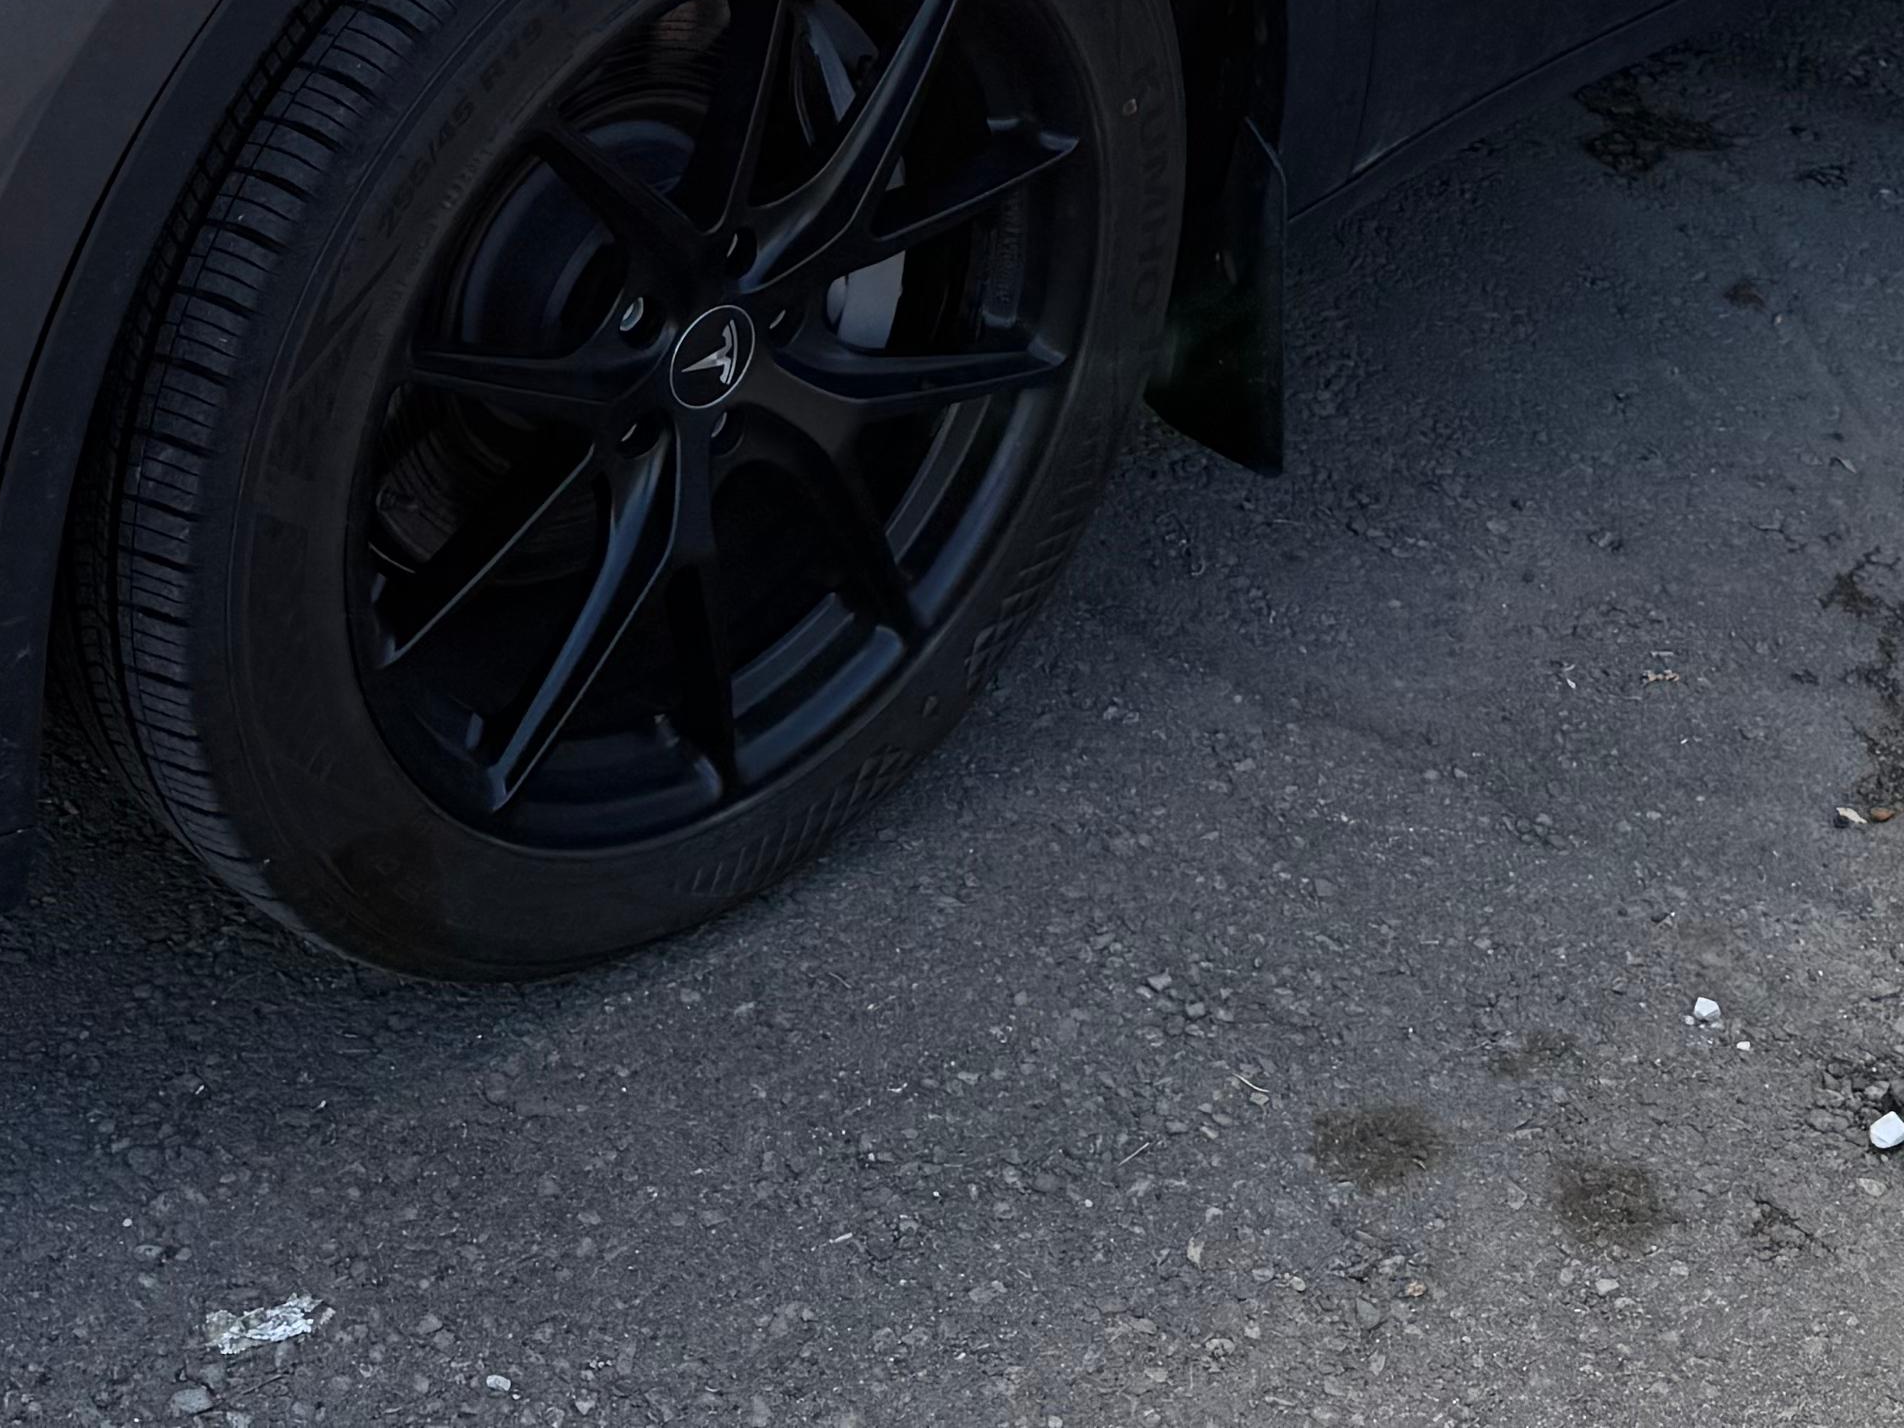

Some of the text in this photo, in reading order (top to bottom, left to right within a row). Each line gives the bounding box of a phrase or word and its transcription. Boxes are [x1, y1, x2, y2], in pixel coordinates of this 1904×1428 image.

[378, 99, 476, 238] 255/45
[480, 17, 544, 91] R19
[1131, 52, 1169, 314] KUMHO
